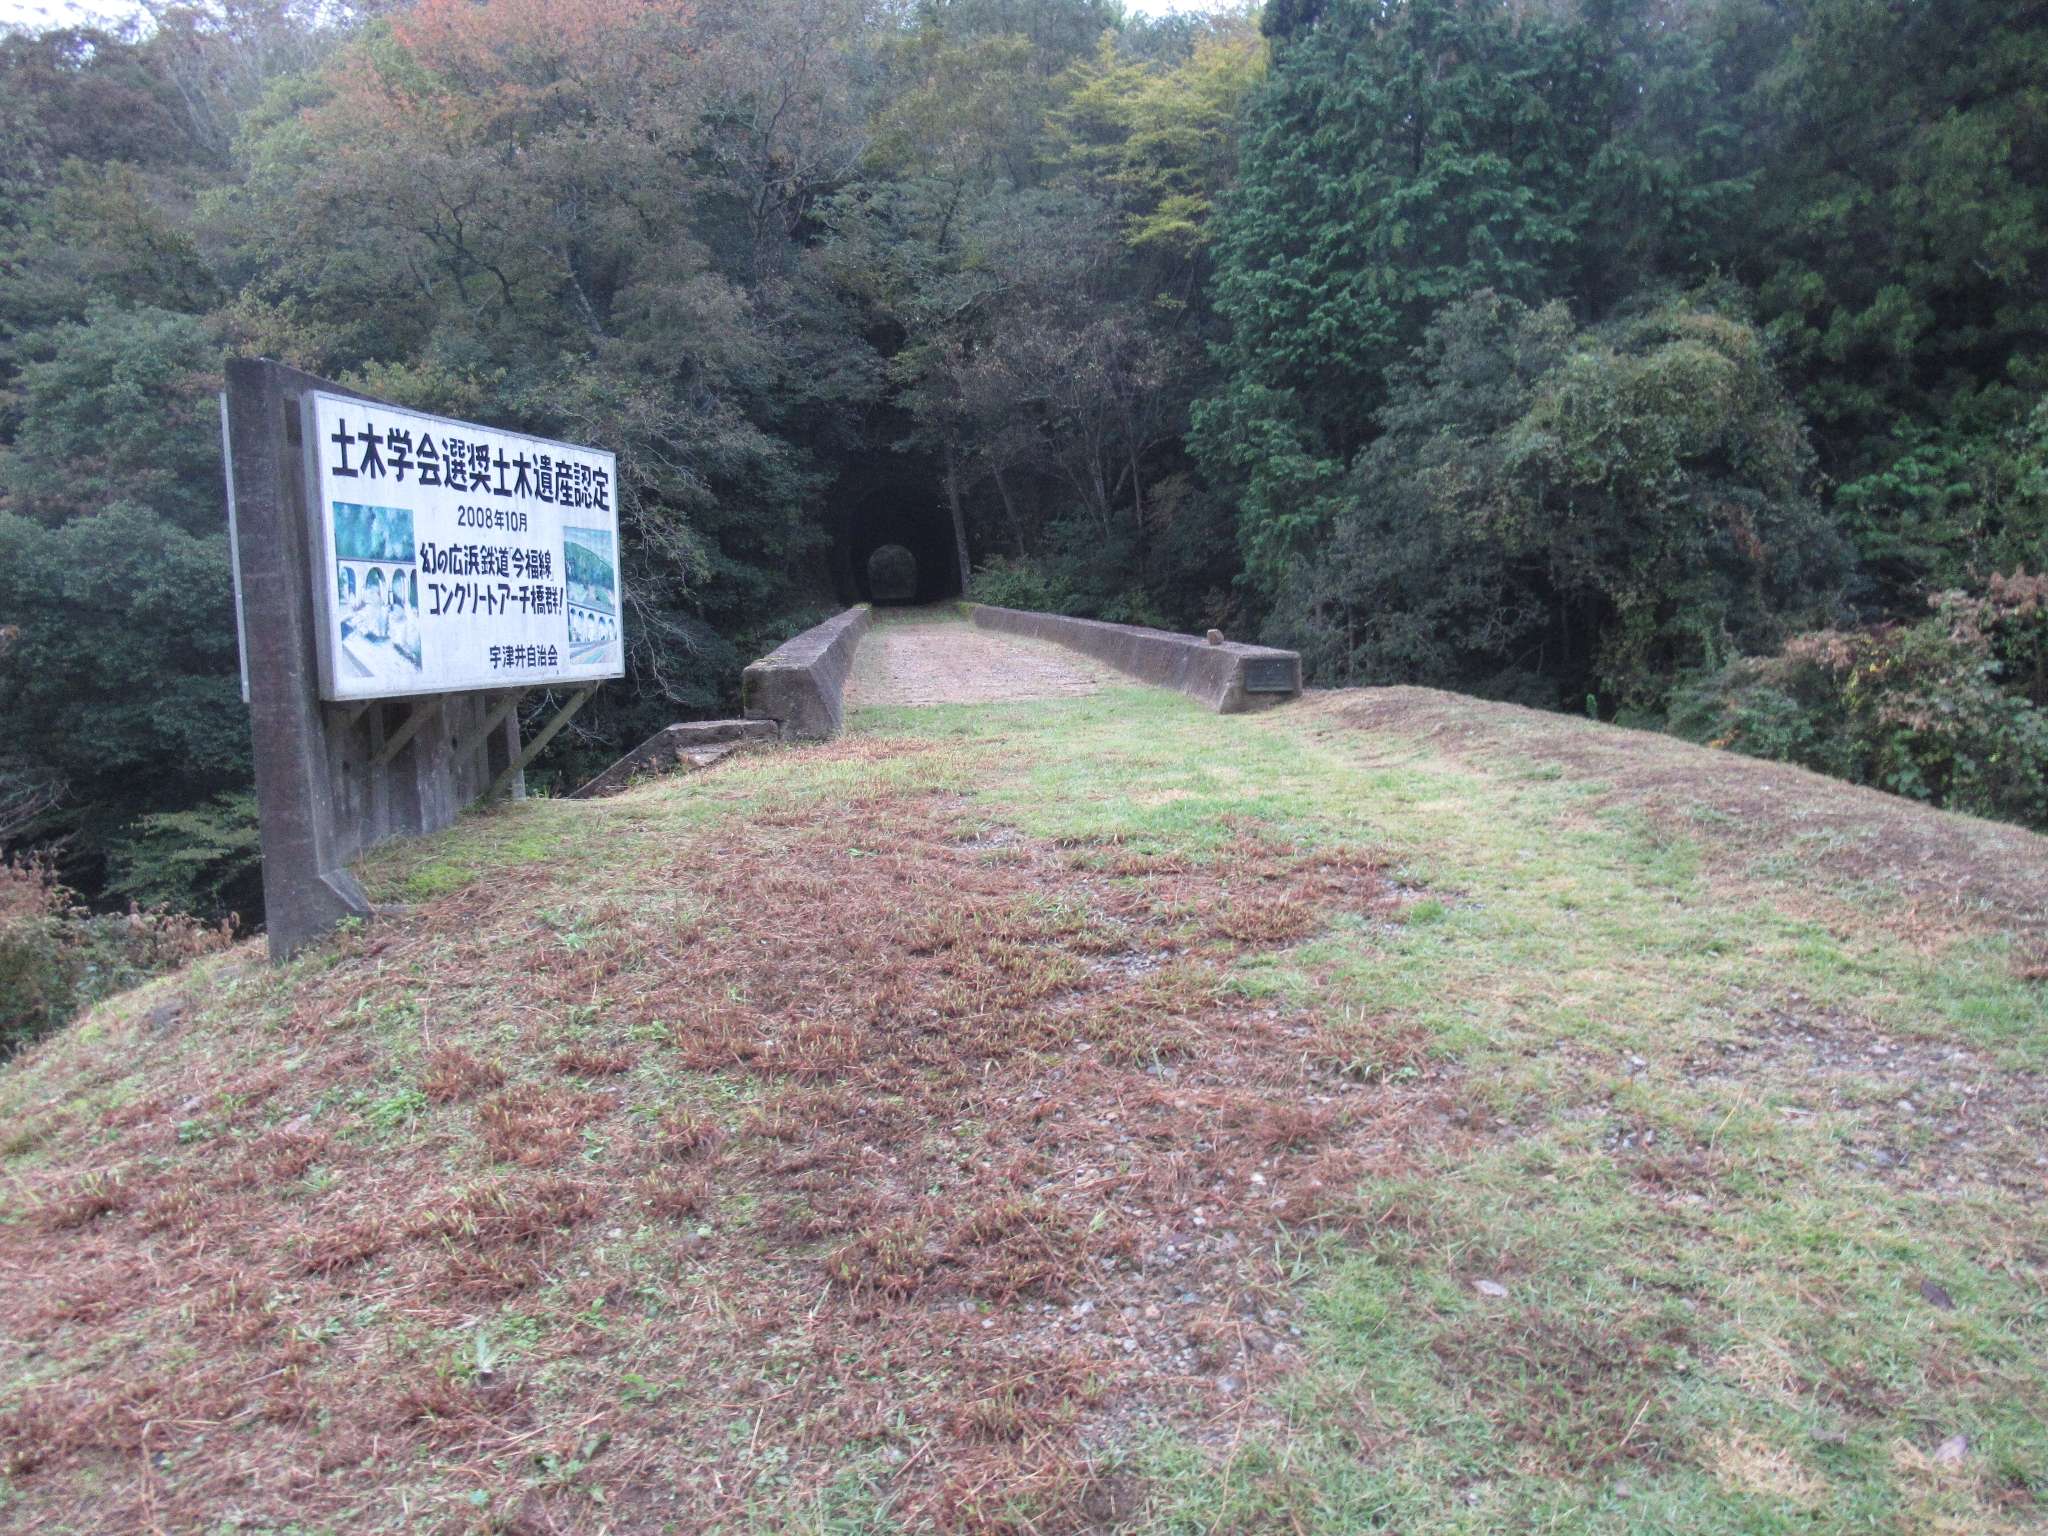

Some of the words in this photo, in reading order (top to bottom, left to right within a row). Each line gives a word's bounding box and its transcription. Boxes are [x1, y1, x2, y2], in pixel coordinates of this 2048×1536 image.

[331, 418, 610, 512] 土木学会選奨土木遺産認定
[457, 505, 528, 533] 2008年10月
[489, 644, 558, 669] 宇津井自治会
